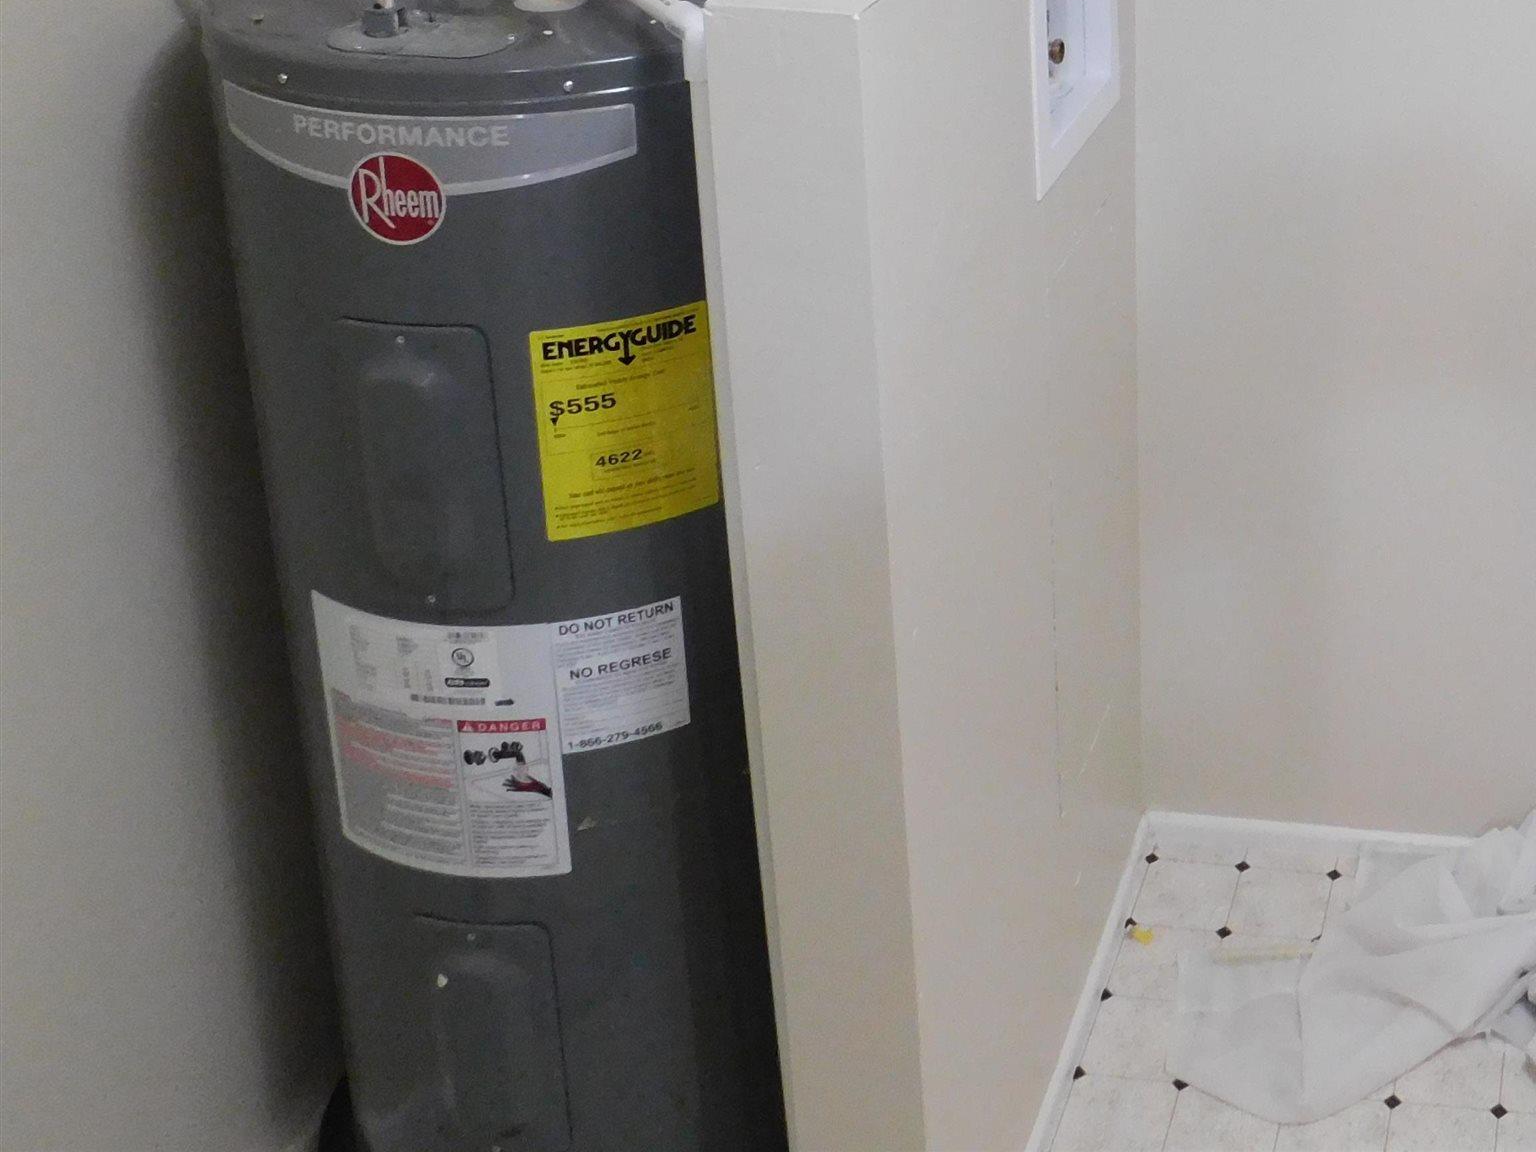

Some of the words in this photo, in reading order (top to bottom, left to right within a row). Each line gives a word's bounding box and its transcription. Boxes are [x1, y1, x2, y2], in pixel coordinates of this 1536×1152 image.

[293, 114, 510, 147] PERFORMANCE
[358, 156, 440, 229] Rheem
[542, 314, 697, 361] ENERGYGUIDE
[550, 393, 617, 416] $555
[595, 449, 643, 467] 4622
[559, 623, 580, 636] DO
[584, 617, 613, 632] NOT
[618, 602, 674, 624] RETURN
[570, 667, 593, 680] NO
[598, 648, 672, 674] REGRESE
[478, 719, 541, 732] DANGER
